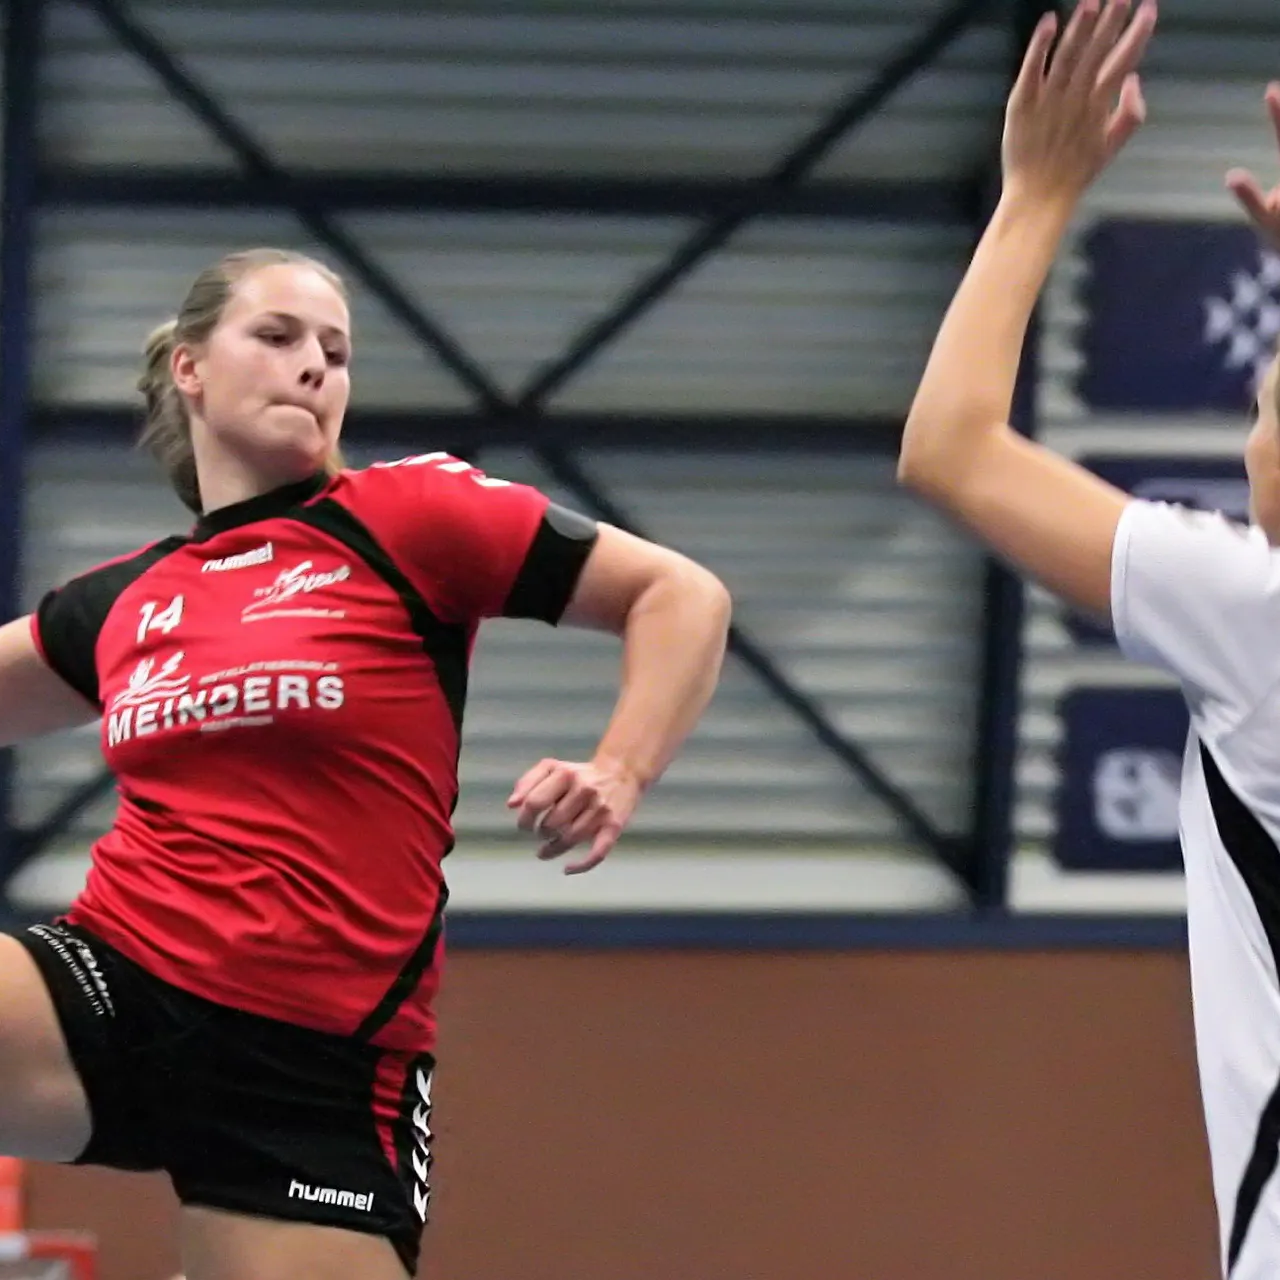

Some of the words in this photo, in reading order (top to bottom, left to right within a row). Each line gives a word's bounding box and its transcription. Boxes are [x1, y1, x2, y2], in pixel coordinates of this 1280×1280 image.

[138, 594, 186, 643] 14
[108, 675, 345, 747] MEINDERS
[288, 1179, 375, 1213] hummel
